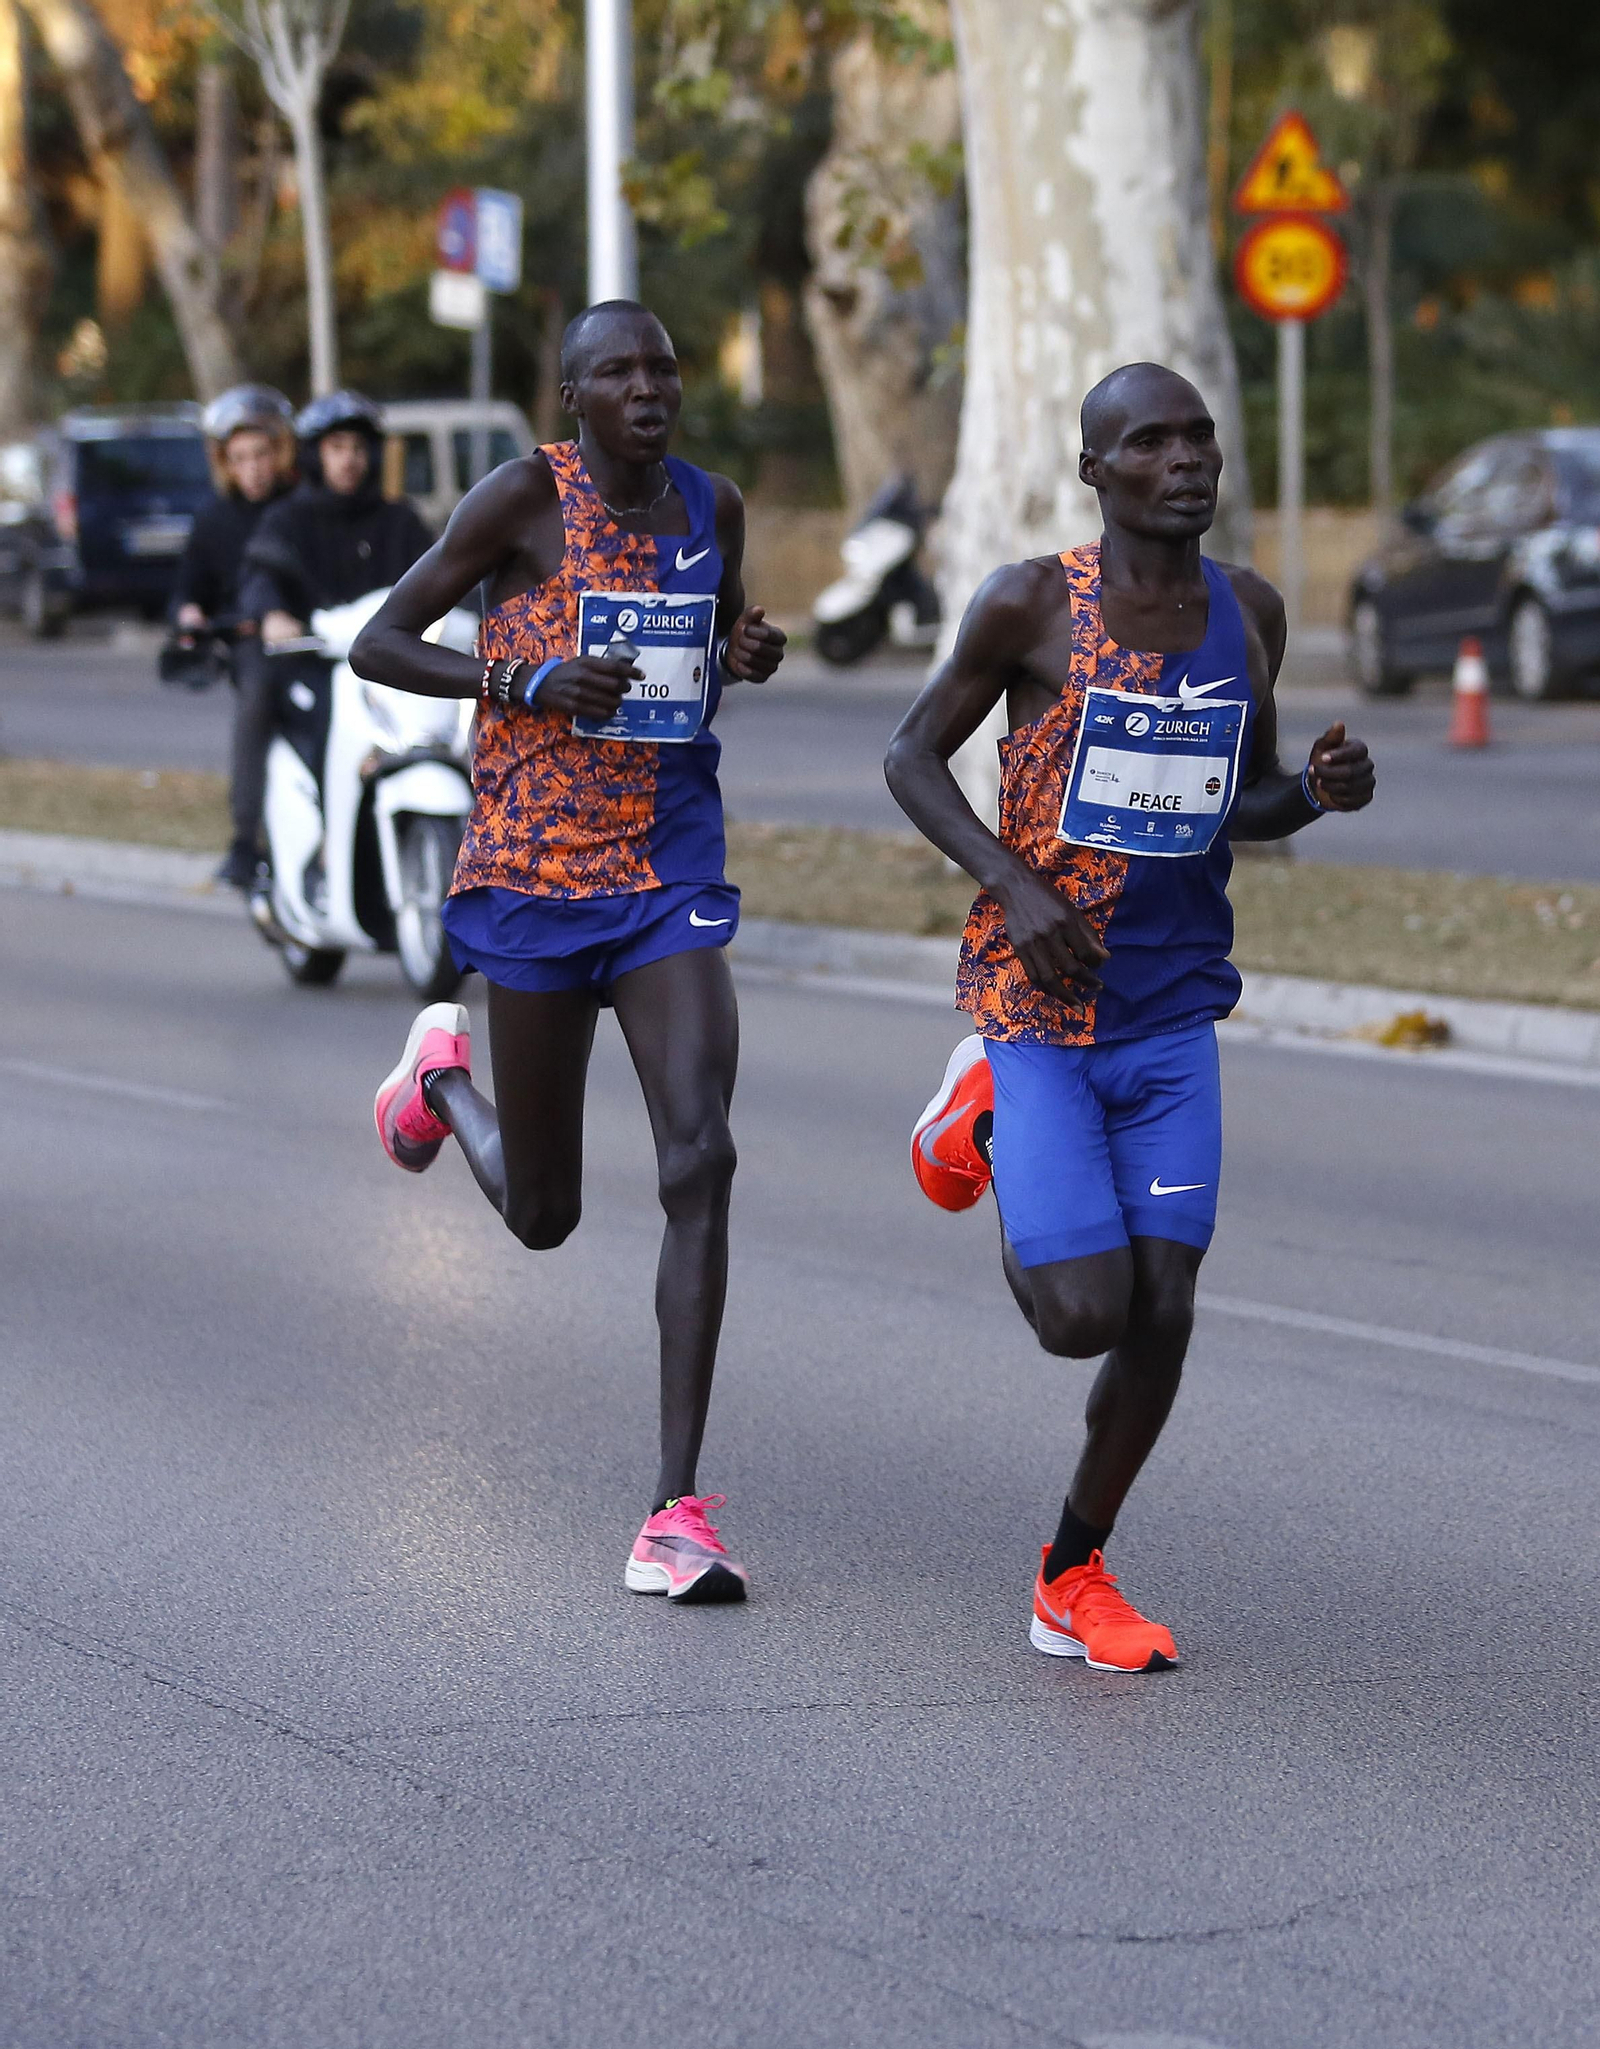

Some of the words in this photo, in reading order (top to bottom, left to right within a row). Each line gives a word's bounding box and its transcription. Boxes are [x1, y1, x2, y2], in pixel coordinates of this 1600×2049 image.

[590, 614, 609, 625] 42K
[642, 614, 695, 630] ZURICH
[640, 684, 670, 698] TOO
[1094, 714, 1116, 726] 42K
[1154, 720, 1212, 736] ZURICH
[1128, 791, 1183, 811] PEACE
